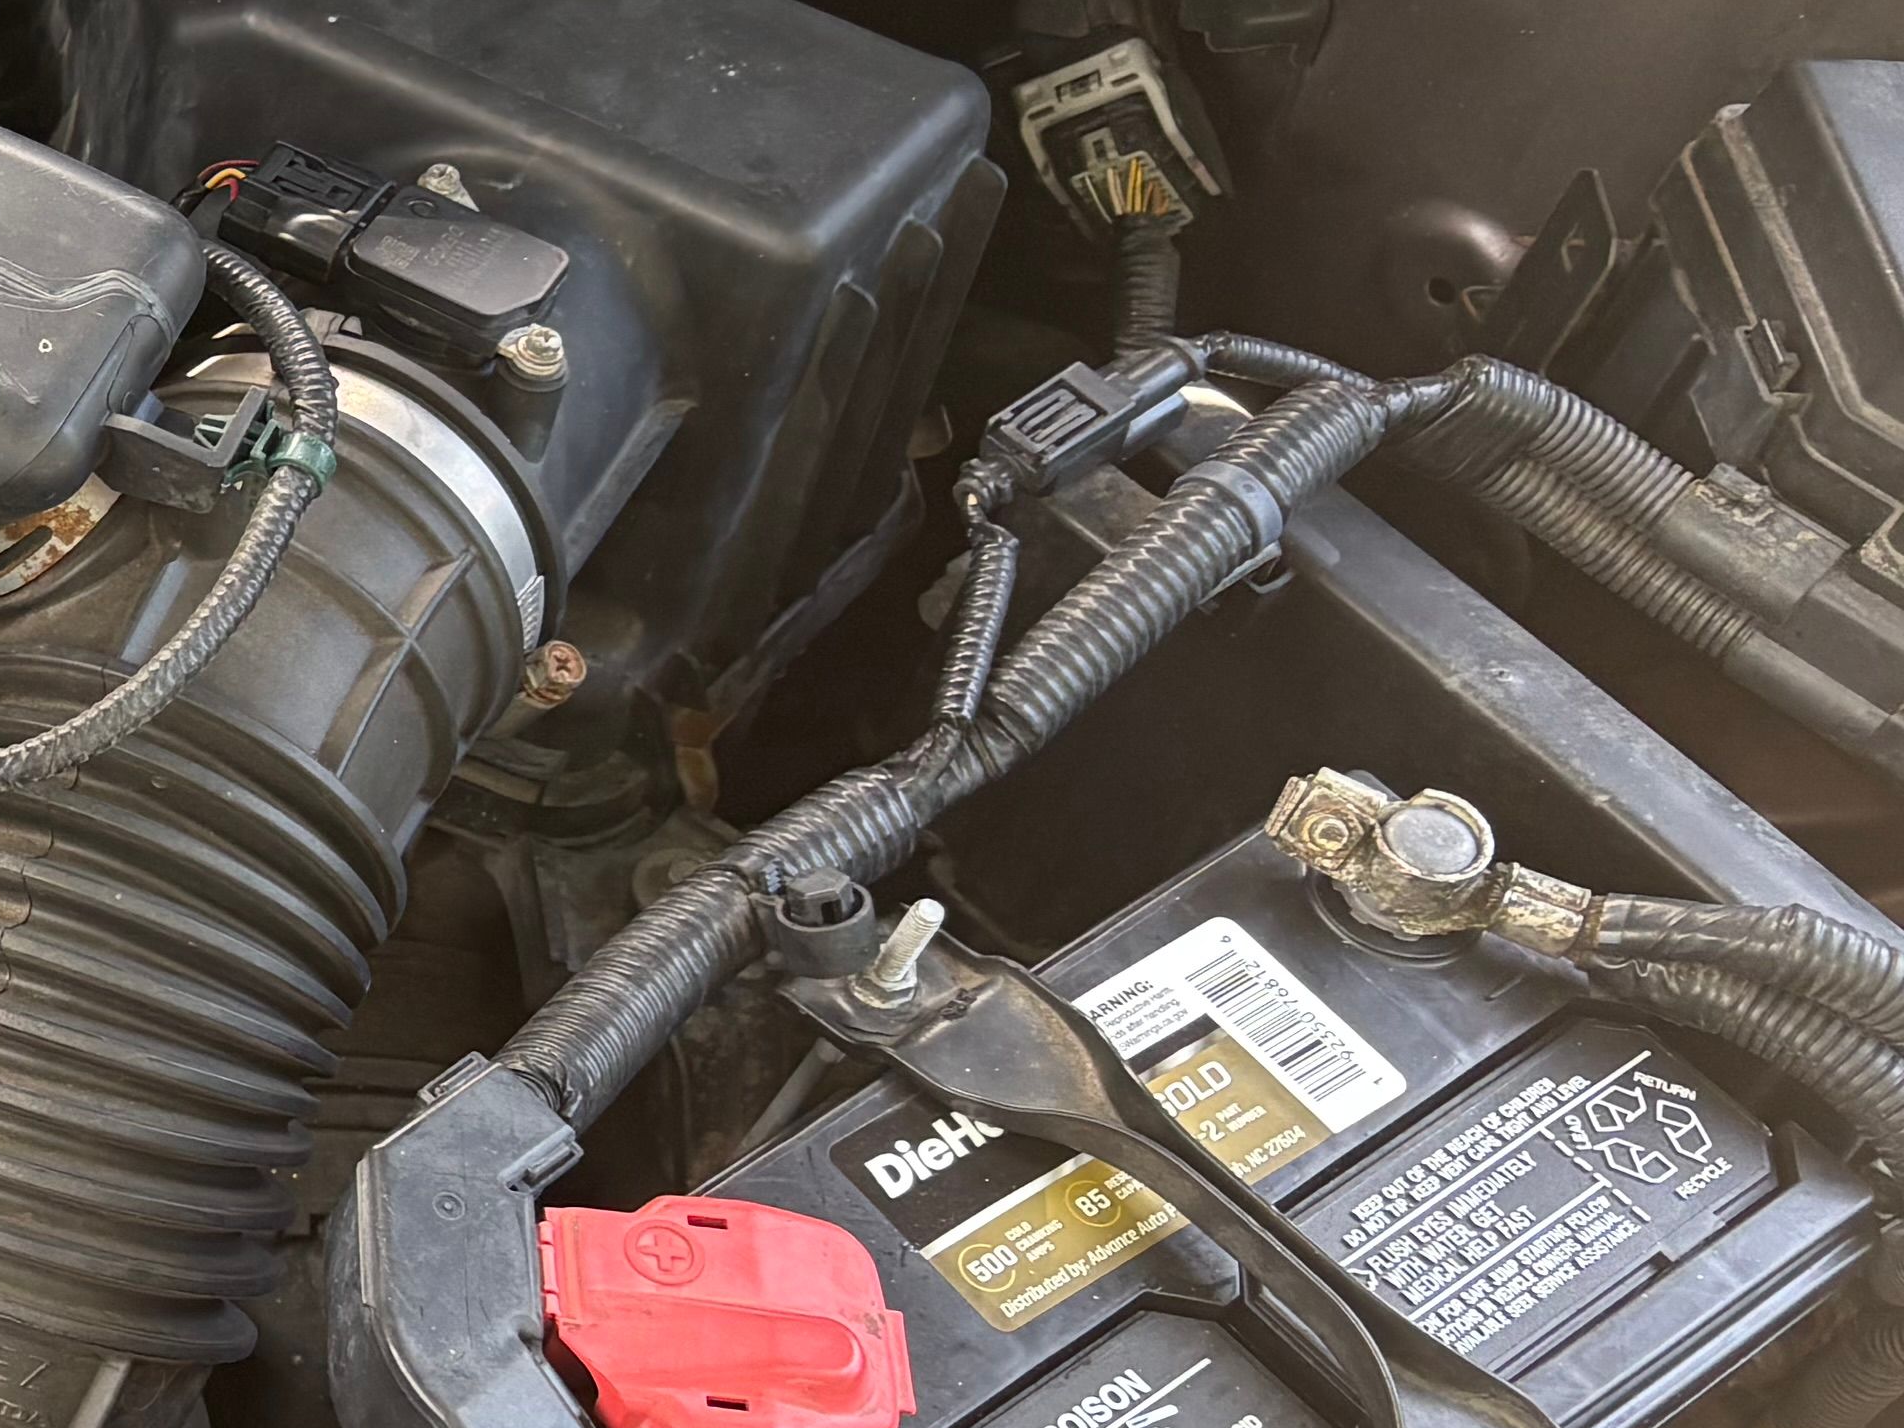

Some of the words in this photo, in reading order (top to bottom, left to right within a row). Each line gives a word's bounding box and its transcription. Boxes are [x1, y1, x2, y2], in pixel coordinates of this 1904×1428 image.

[1088, 979, 1154, 1022] ARNING:
[1153, 1060, 1233, 1121] GOLD
[1633, 1071, 1696, 1101] RETURN
[1215, 1103, 1241, 1122] PART
[1226, 1105, 1267, 1133] NUMBER
[1565, 1114, 1593, 1152] LEAD
[1342, 1227, 1365, 1249] DO
[1363, 1211, 1391, 1233] NOT
[1410, 1179, 1443, 1202] KEEP
[1439, 1160, 1471, 1184] VENT
[1468, 1140, 1503, 1168] CAPS
[1500, 1117, 1534, 1147] TIGHT
[1531, 1099, 1557, 1121] AND
[1552, 1075, 1591, 1109] LEVEL
[1352, 1193, 1384, 1221] KEEP
[1382, 1179, 1410, 1201] OUT
[1405, 1166, 1426, 1186] OF
[1422, 1152, 1447, 1172] THE
[1444, 1124, 1486, 1160] REACH
[1482, 1111, 1502, 1132] OF
[1499, 1077, 1557, 1121] CHILDREN
[1675, 1157, 1733, 1199] RECYCLE
[1074, 1188, 1112, 1217] 85
[1366, 1236, 1419, 1275] FLUSH
[1415, 1214, 1454, 1244] EYES
[1450, 1150, 1538, 1219] IMMEDIATELY
[1004, 1221, 1032, 1242] COLD
[1015, 1219, 1063, 1252] CRANKING
[1026, 1241, 1056, 1263] AMPS
[1382, 1255, 1430, 1289] WITH
[1471, 1201, 1506, 1229] GET
[966, 1244, 1019, 1283] 500
[1000, 1266, 1071, 1319] Distributed
[1068, 1257, 1090, 1280] by:
[1089, 1227, 1140, 1267] Advance
[1139, 1210, 1169, 1236] Auto
[1401, 1259, 1467, 1306] MEDICAL
[1463, 1234, 1500, 1268] HELP
[1498, 1206, 1537, 1240] FAST
[1441, 1296, 1467, 1322] FOR
[1462, 1276, 1494, 1304] SAFE
[1491, 1257, 1522, 1285] JUMP
[1519, 1224, 1570, 1265] STARTING
[1566, 1196, 1611, 1233] FOLLOW
[1479, 1301, 1495, 1318] IN
[1491, 1272, 1538, 1309] VEHICLE
[1533, 1241, 1583, 1281] OWNERS
[1509, 1292, 1540, 1317] SEEK
[1536, 1263, 1582, 1297] SERVICE
